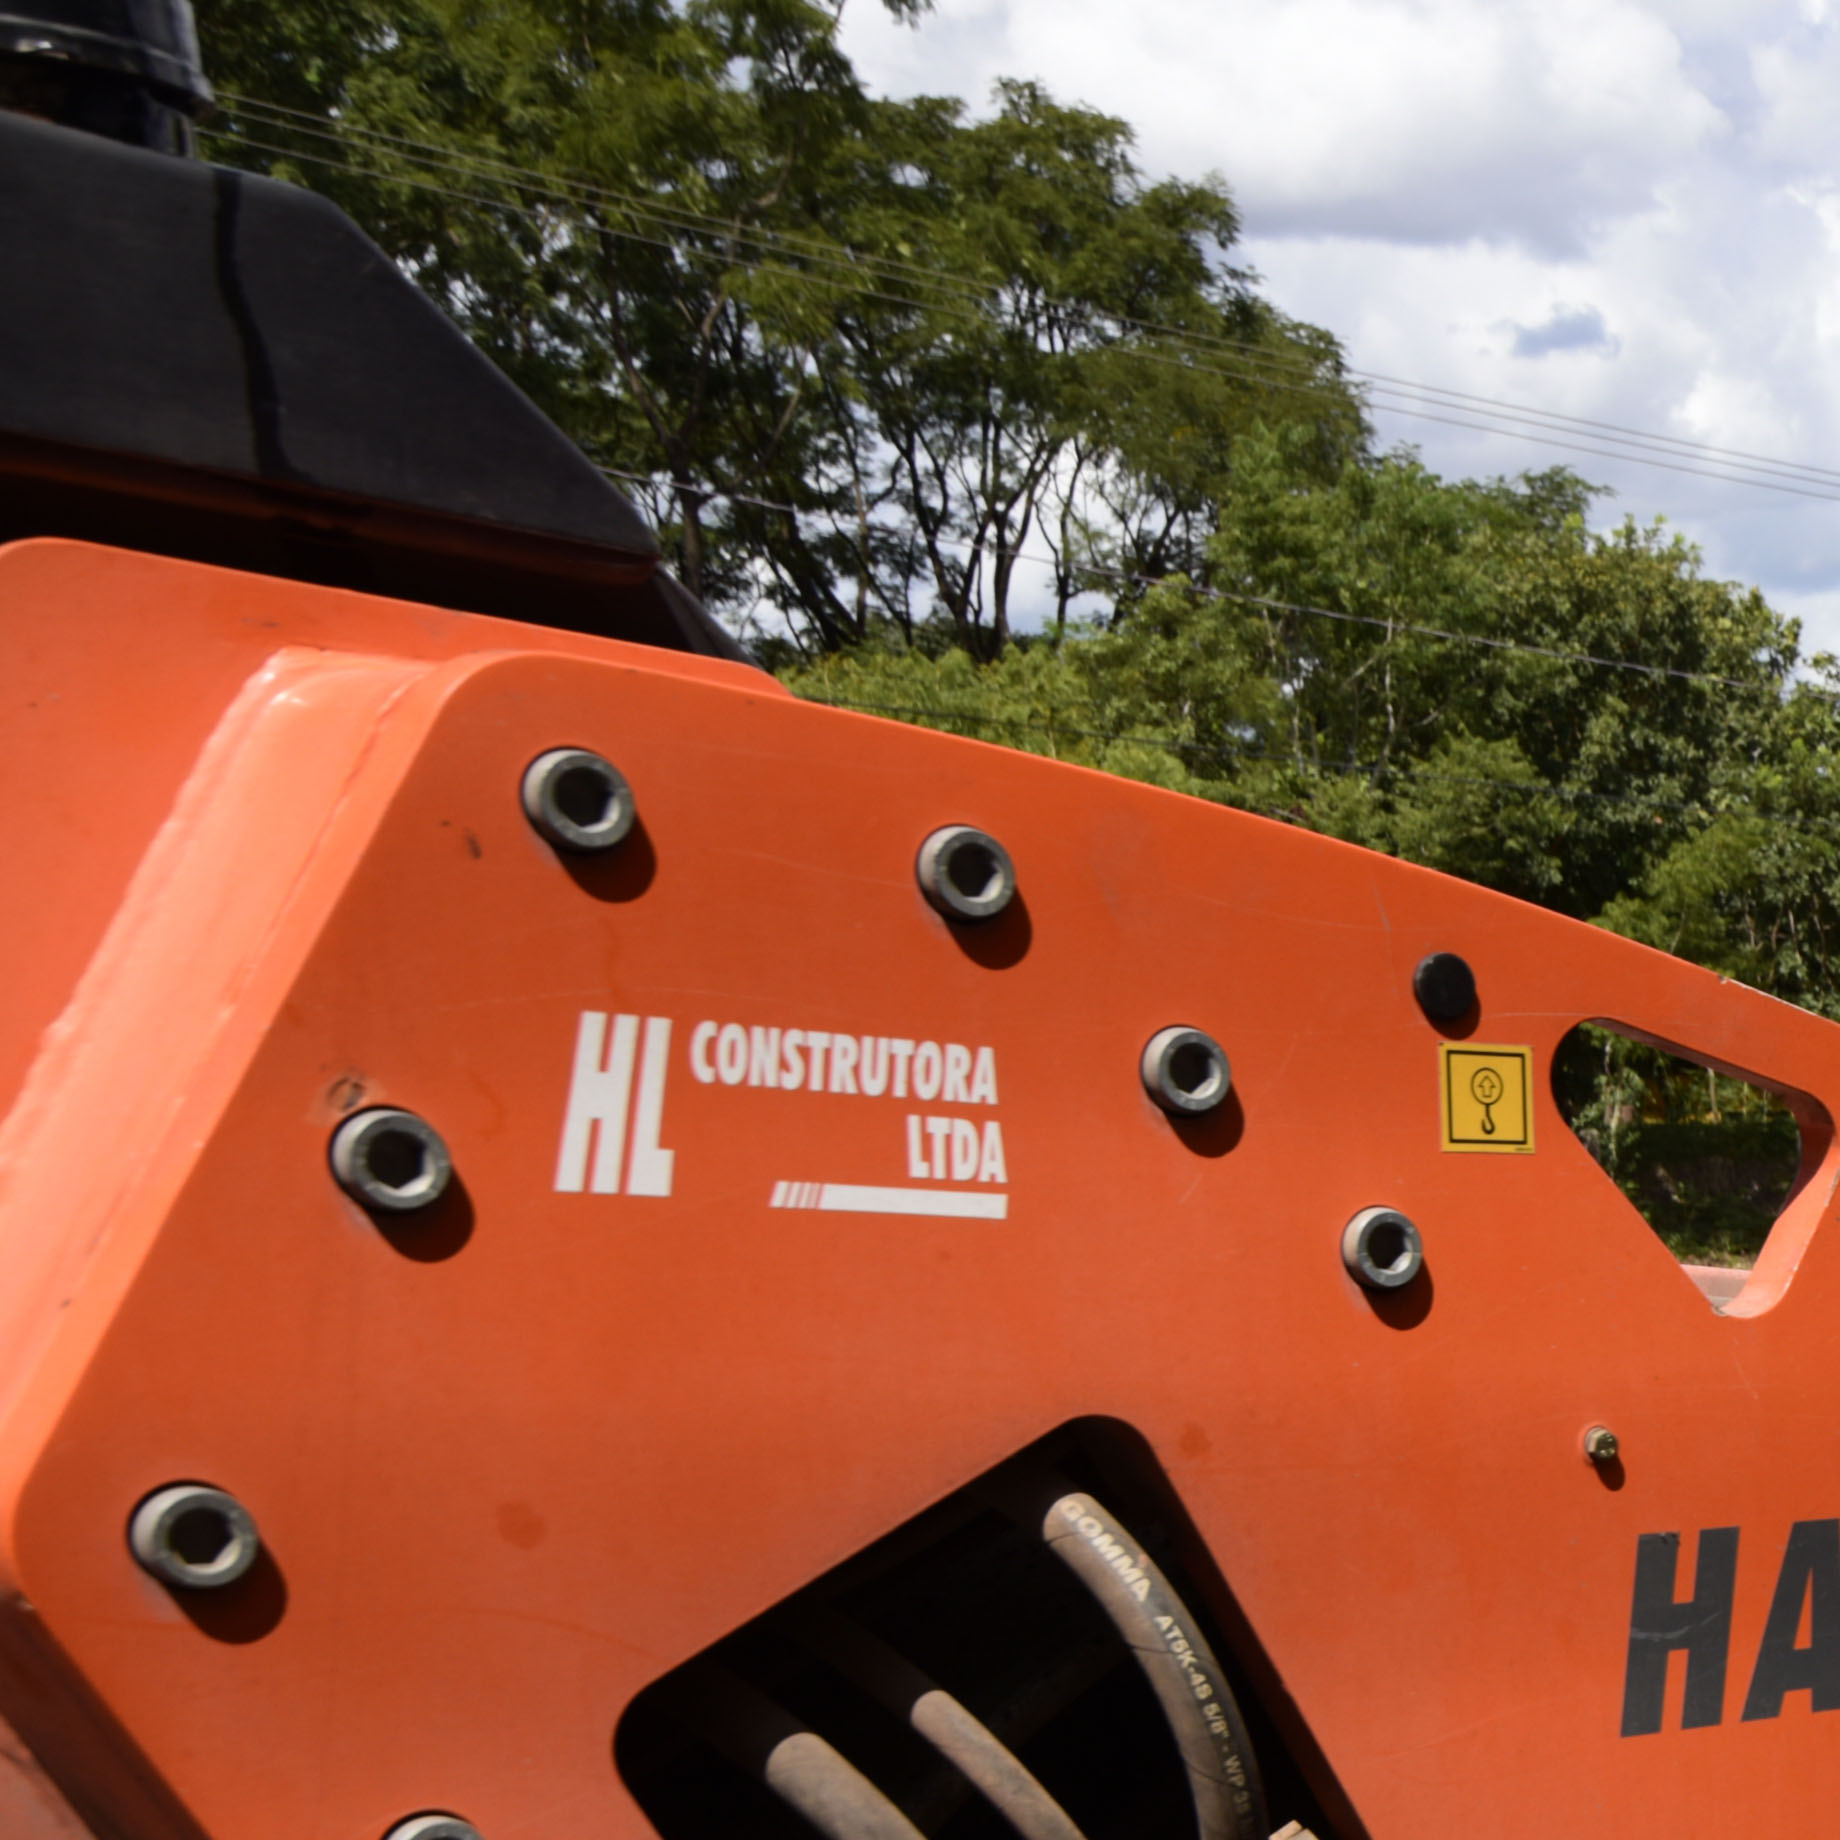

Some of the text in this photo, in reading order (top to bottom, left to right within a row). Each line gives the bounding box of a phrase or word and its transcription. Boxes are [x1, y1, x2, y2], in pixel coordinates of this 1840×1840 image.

[553, 1010, 998, 1197] HL CONSTRUTORA
[906, 1114, 1008, 1184] LTDA
[1061, 1500, 1151, 1602] GOMMA
